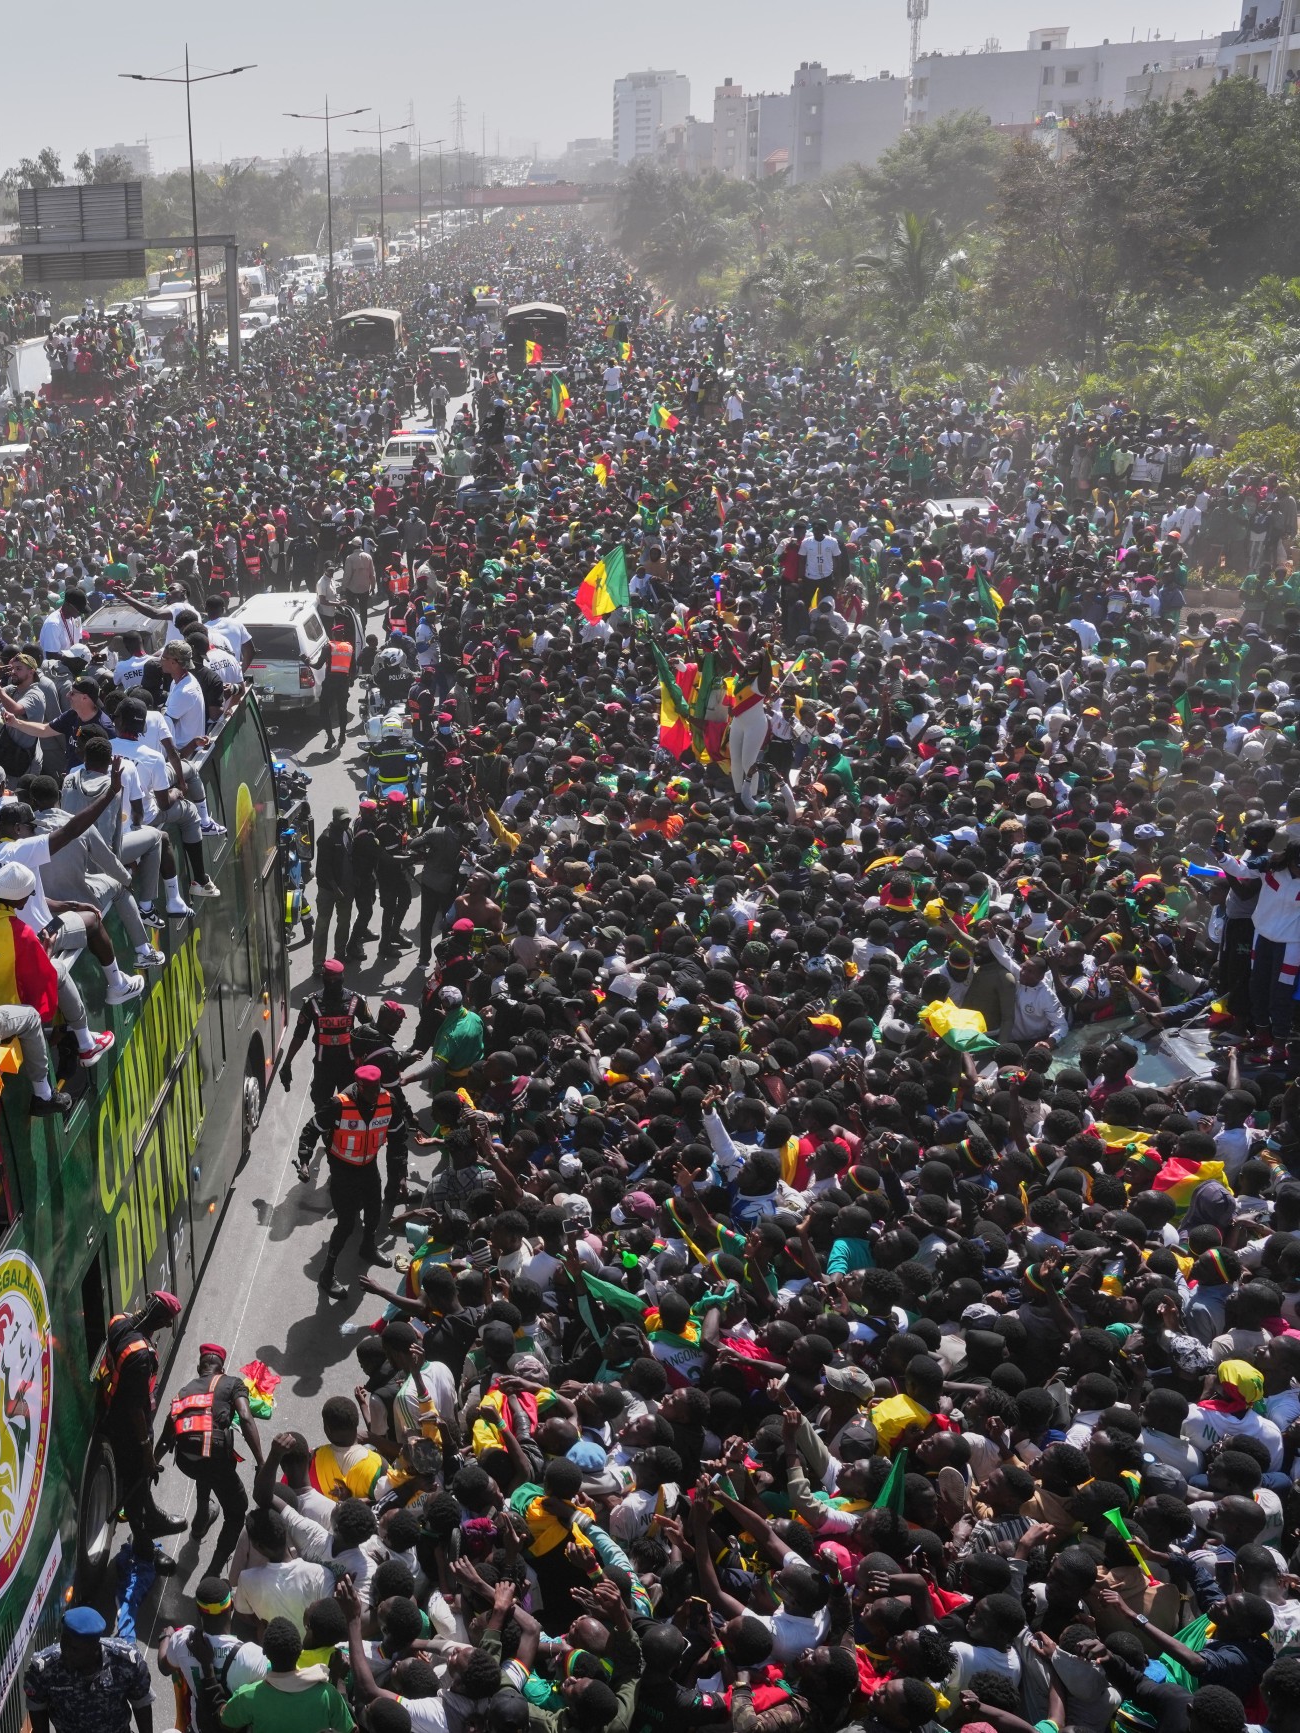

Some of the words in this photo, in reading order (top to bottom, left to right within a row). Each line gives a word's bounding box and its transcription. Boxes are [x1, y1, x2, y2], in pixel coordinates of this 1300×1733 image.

[816, 556, 824, 564] 15
[320, 1017, 351, 1027] POLICE
[99, 927, 207, 1214] CHAMPIONS
[371, 1117, 391, 1127] POLICE
[42, 1364, 49, 1409] DE
[173, 1393, 213, 1413] POLICE
[4, 1422, 47, 1569] FOOTBALL
